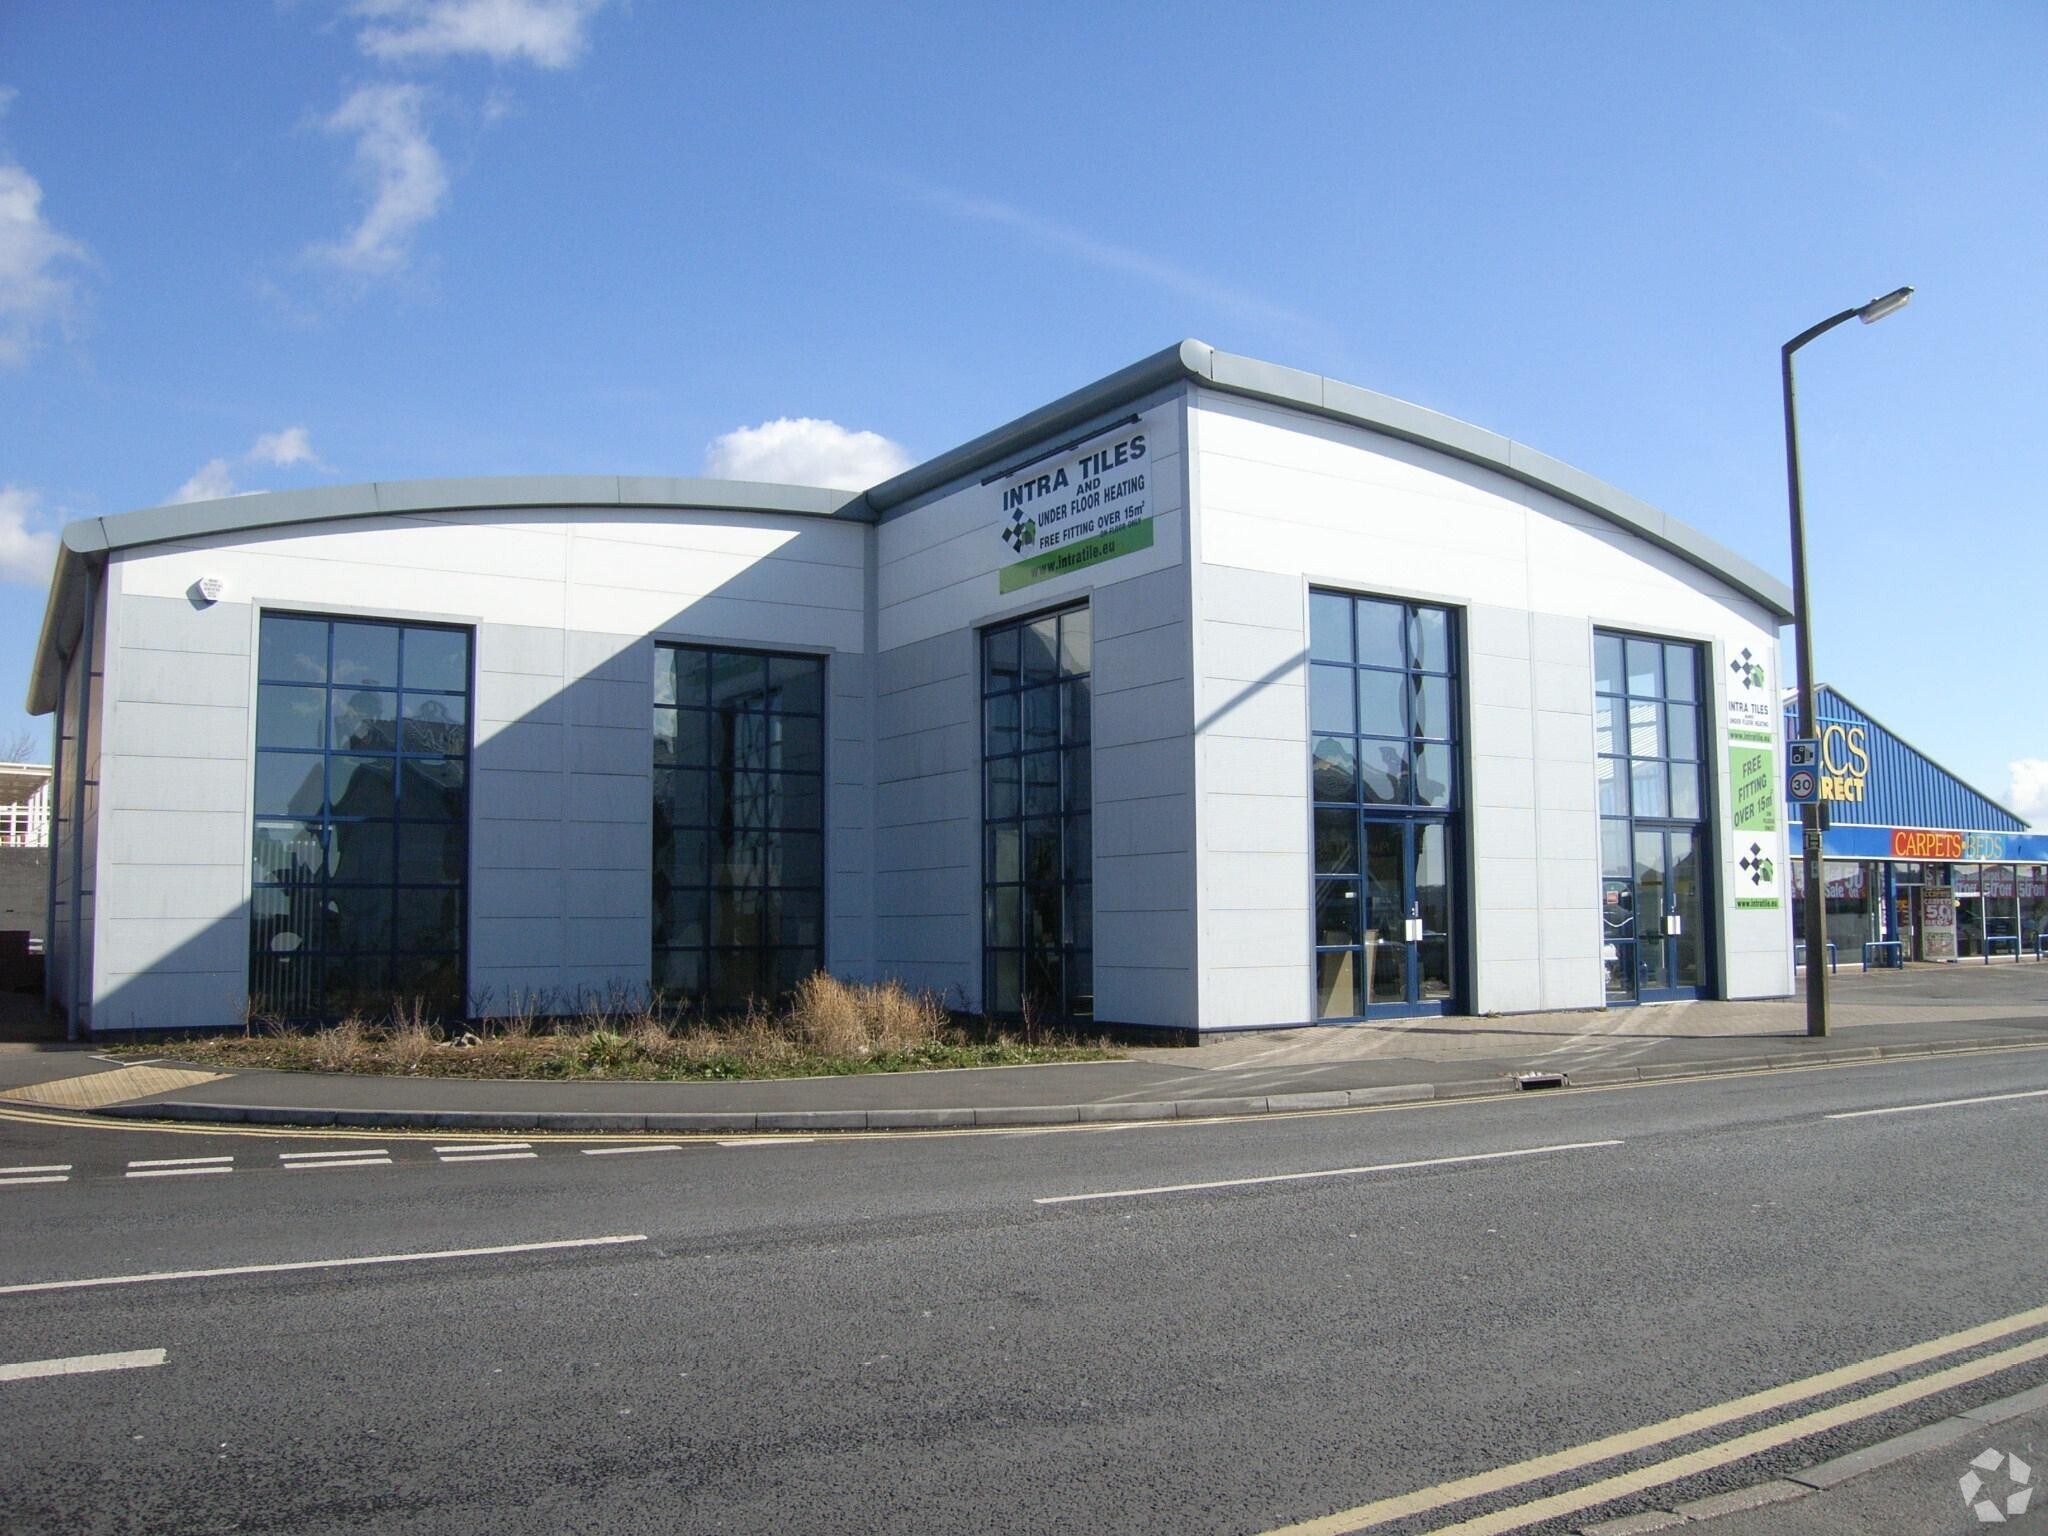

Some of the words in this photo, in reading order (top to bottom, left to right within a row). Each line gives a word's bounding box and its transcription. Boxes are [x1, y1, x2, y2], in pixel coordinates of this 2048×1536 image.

[1003, 467, 1069, 511] INTRA
[1079, 435, 1146, 480] TILES
[1076, 478, 1100, 496] AND
[1038, 502, 1067, 528] UNDER
[1071, 491, 1100, 516] FLOOR
[1104, 474, 1145, 507] HEATING
[1040, 532, 1060, 549] FREE
[1063, 520, 1094, 541] FITTING
[1098, 510, 1121, 528] OVER
[1031, 540, 1116, 578] www.intratile.eu
[1728, 700, 1749, 713] INTRA
[1751, 703, 1769, 716] TILES
[1742, 754, 1762, 779] FREE
[1738, 773, 1767, 803] FITTING
[1793, 779, 1811, 791] 30
[1734, 802, 1755, 827] OVER
[1895, 831, 1962, 858] CARPETS
[1967, 835, 2004, 859] BEDS
[1824, 881, 1845, 898] Sale
